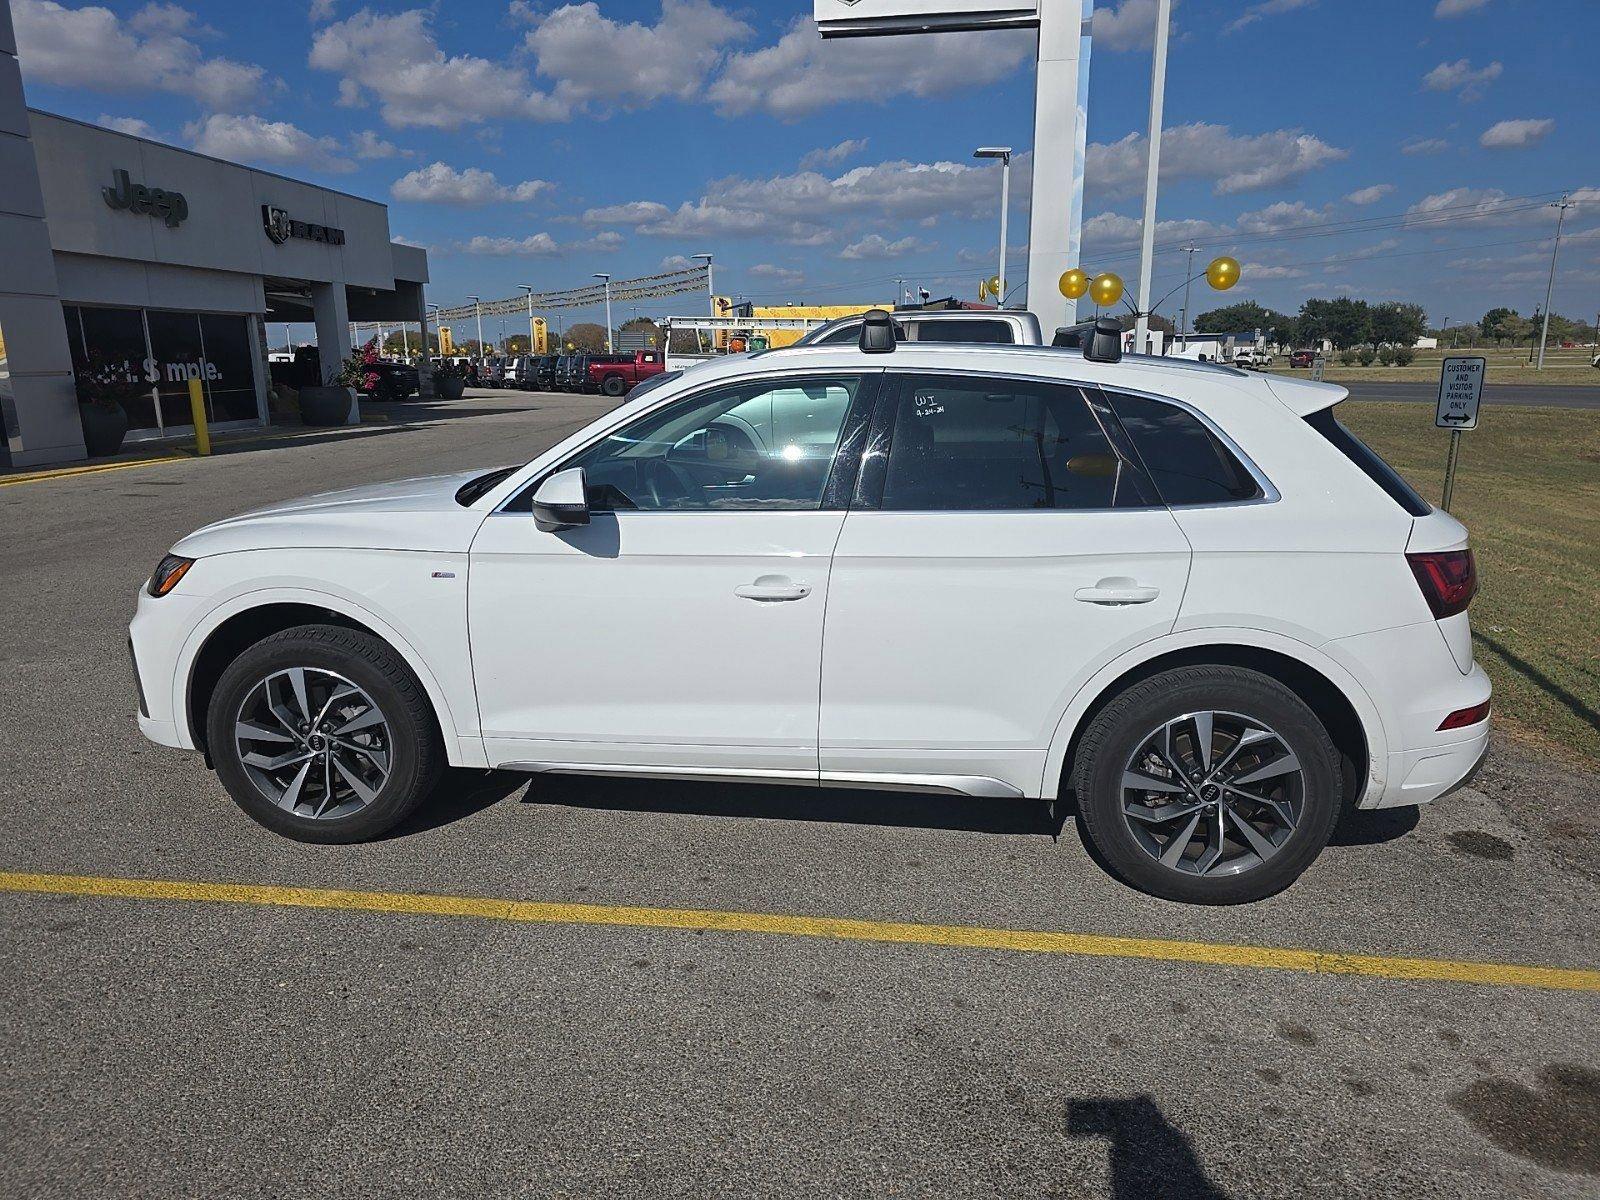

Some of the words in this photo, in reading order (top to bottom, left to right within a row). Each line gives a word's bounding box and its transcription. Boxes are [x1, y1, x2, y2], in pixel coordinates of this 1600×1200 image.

[101, 168, 189, 229] Jeep
[290, 220, 346, 246] RAM
[1446, 392, 1473, 400] PARKING
